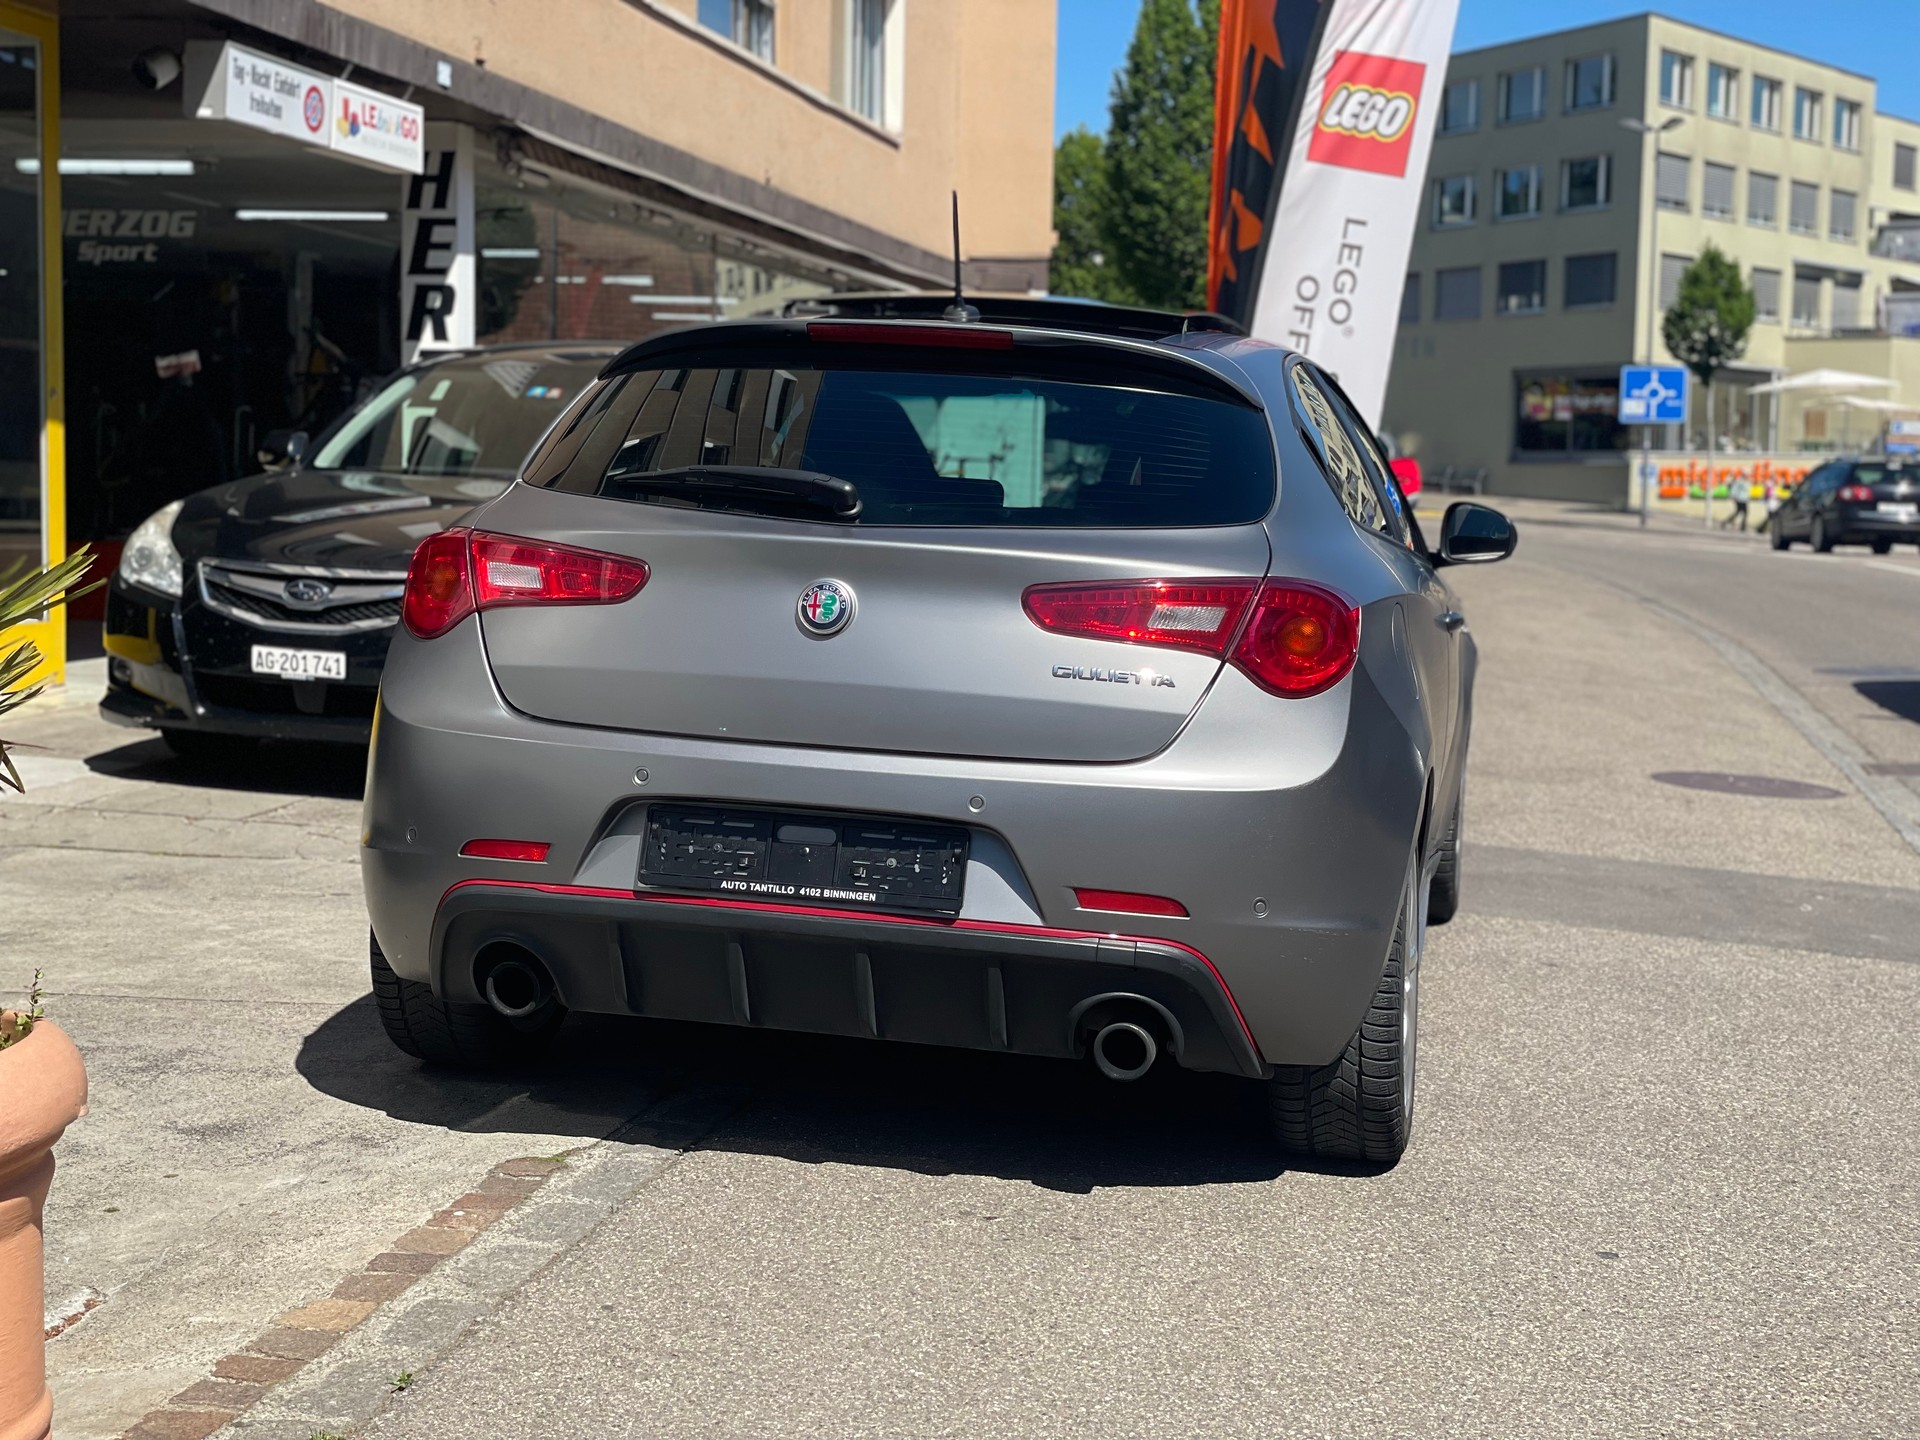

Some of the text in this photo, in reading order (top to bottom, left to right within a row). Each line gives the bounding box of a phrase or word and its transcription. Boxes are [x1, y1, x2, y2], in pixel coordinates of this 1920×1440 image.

[1321, 86, 1412, 139] LEGO
[77, 240, 159, 266] Sport
[406, 152, 457, 356] HER
[1659, 459, 1809, 491] migrlino
[802, 584, 846, 609] ALFA ROMEO
[1052, 664, 1176, 688] GIULIETTA
[720, 880, 877, 902] AUTO TANTILLO 4102 BINNINGEN
